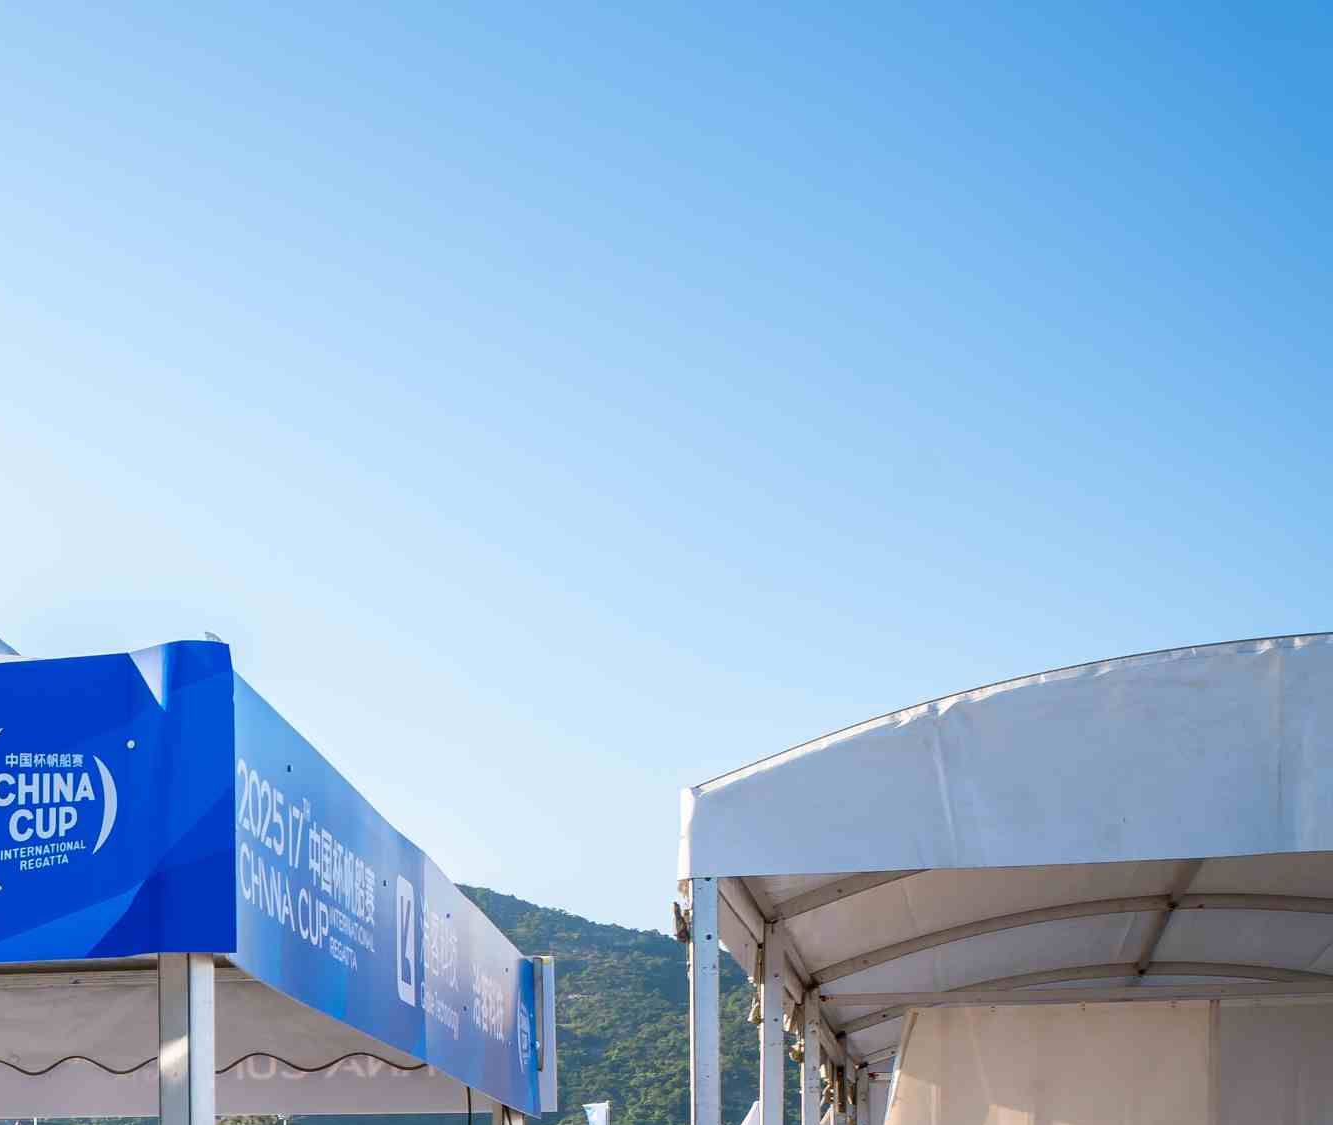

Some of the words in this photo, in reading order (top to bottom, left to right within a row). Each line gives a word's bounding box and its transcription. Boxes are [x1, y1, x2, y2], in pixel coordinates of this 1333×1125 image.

[5, 752, 84, 768] 中国杯帆船赛
[237, 757, 285, 857] 2025
[8, 806, 78, 842] CUP
[0, 839, 86, 862] INTERNATIONAL
[19, 854, 69, 872] REGATTA
[239, 842, 296, 933] CHINA
[298, 887, 330, 950] CUP
